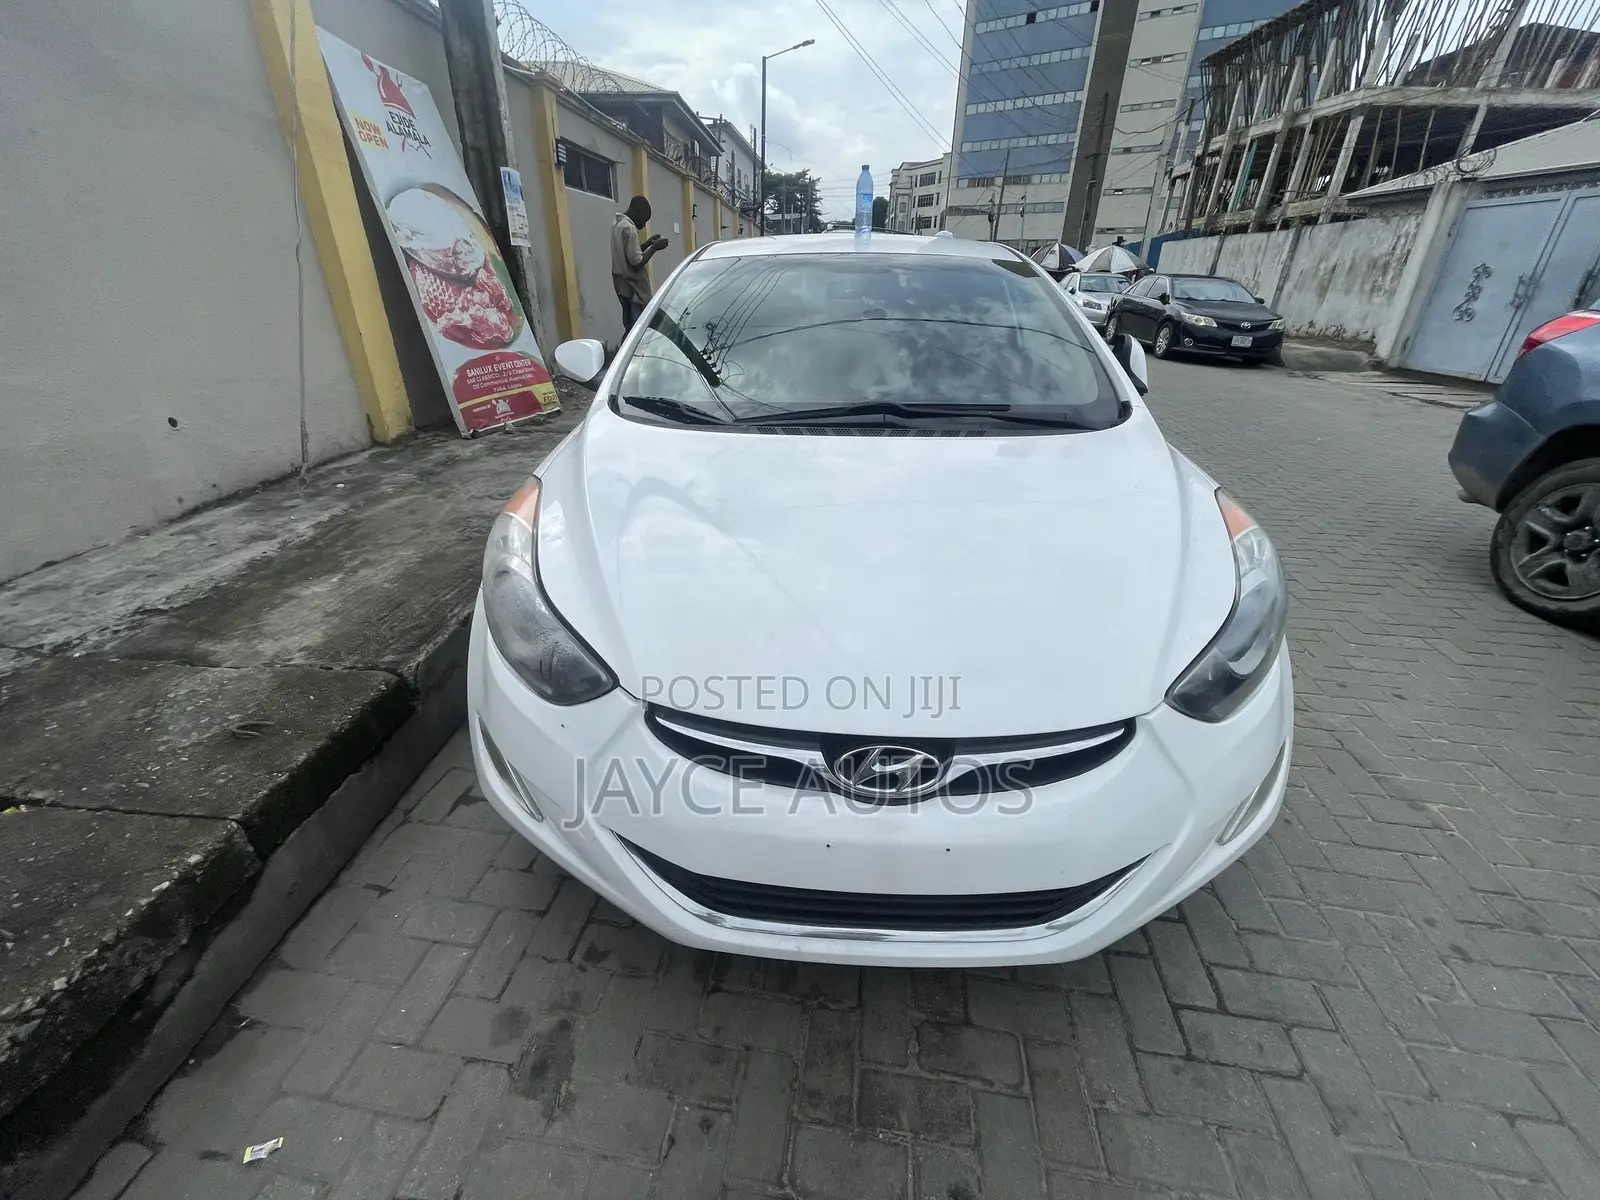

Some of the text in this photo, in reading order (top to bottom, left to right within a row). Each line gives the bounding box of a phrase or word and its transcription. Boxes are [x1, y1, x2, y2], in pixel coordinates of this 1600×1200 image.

[354, 117, 381, 135] NOW
[358, 131, 389, 149] OPEN
[493, 360, 514, 372] EVENT
[513, 358, 531, 368] CENTER
